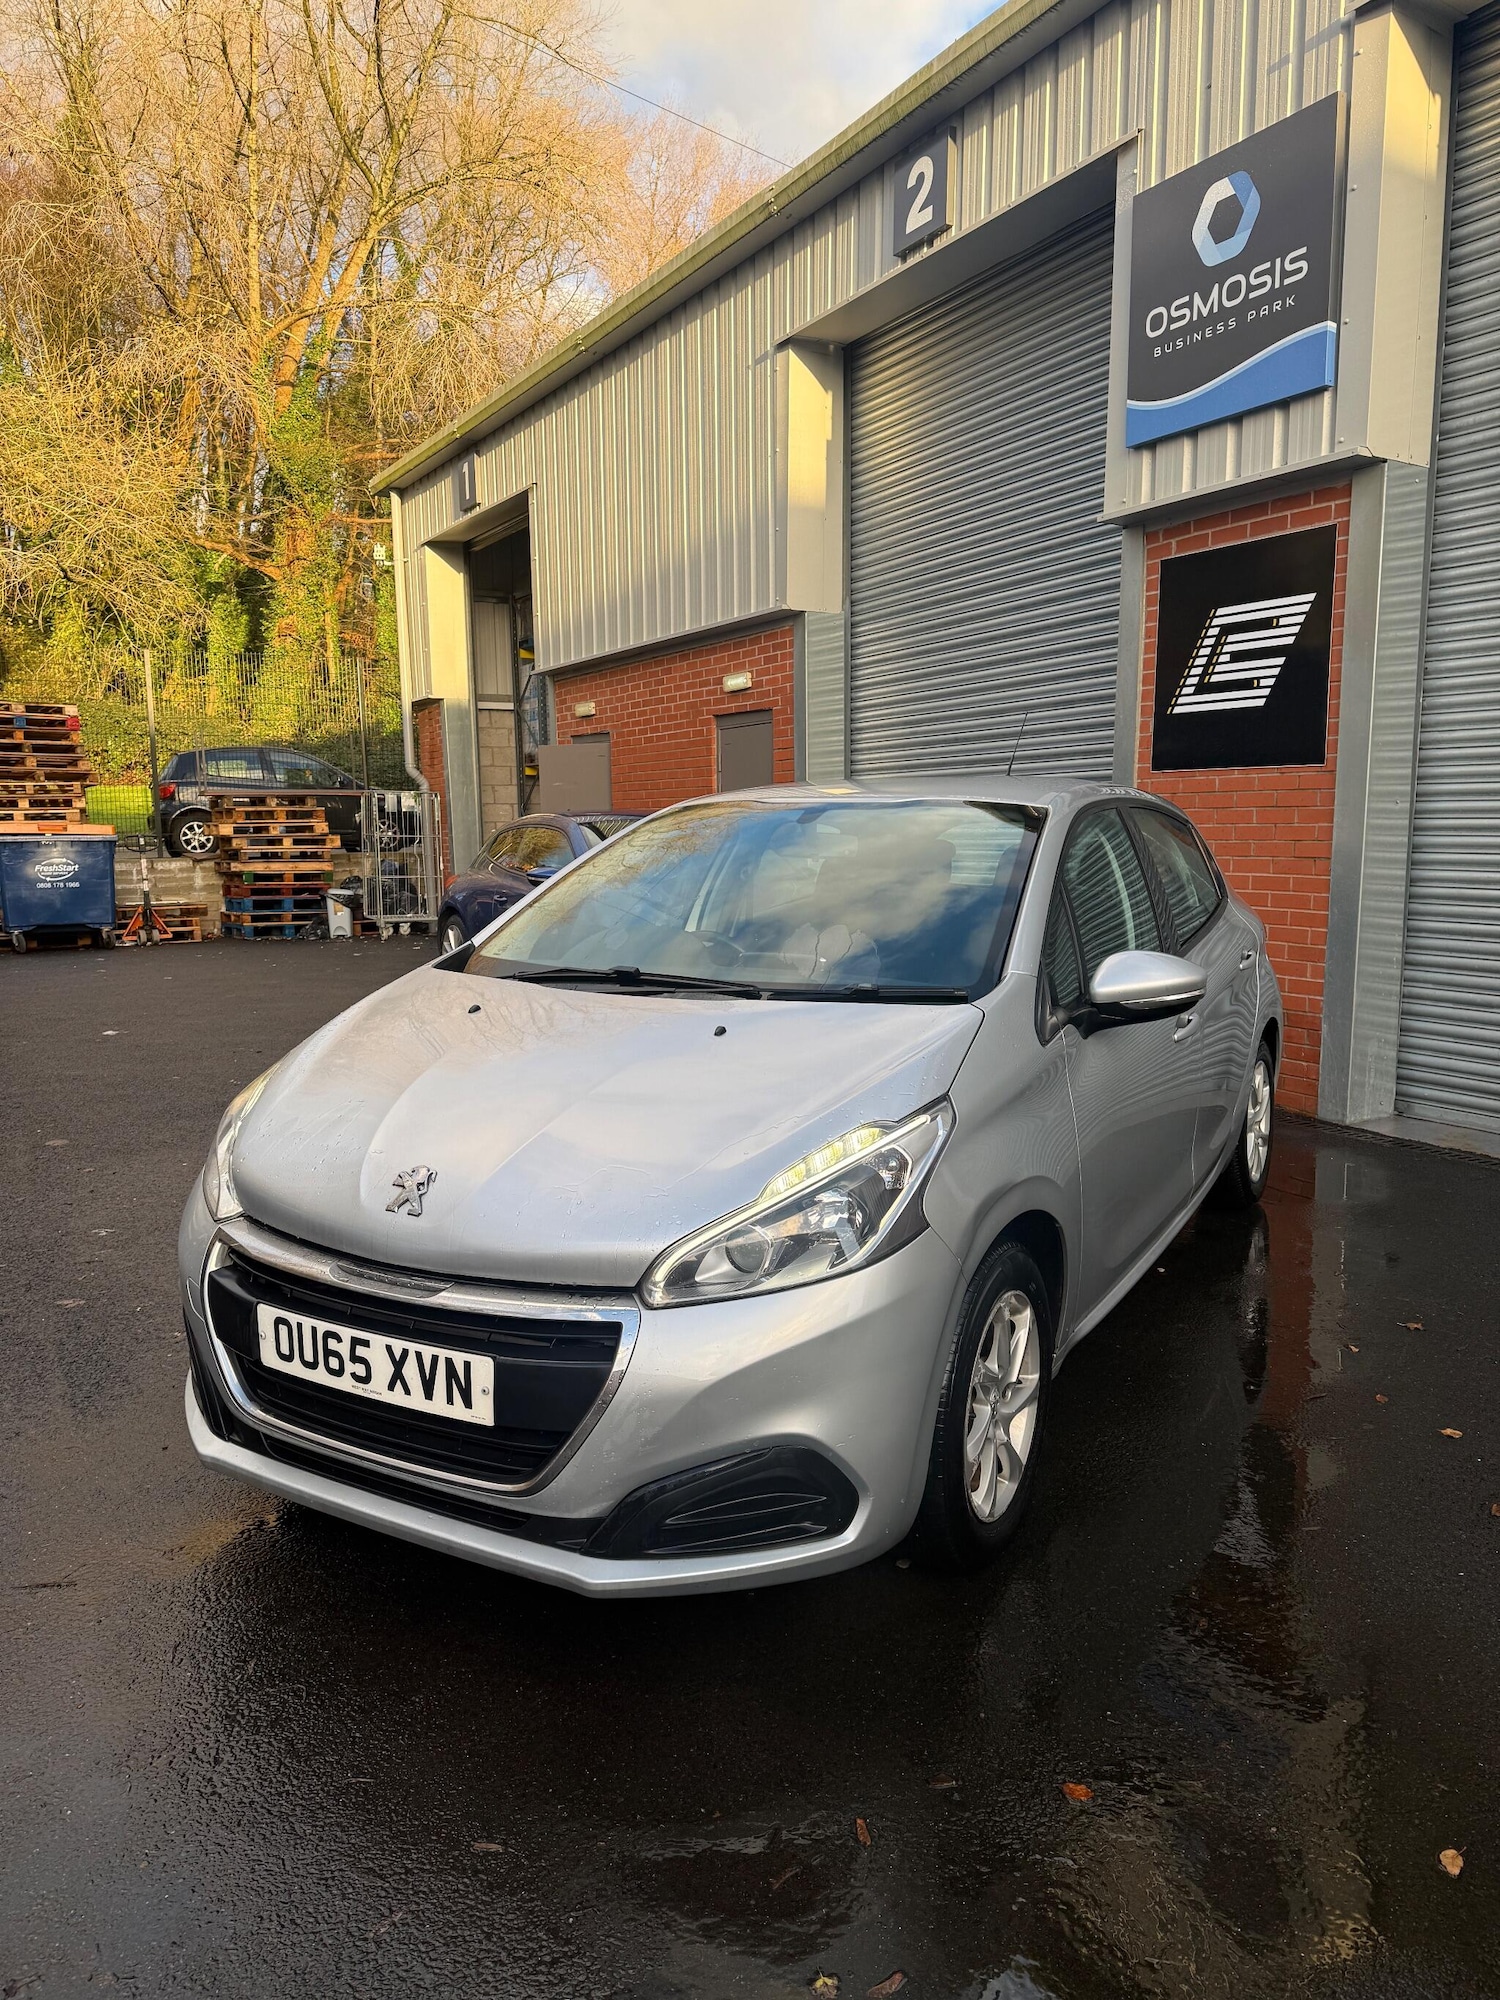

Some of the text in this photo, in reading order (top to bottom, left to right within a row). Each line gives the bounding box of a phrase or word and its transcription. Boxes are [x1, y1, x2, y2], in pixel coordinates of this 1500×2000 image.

[906, 155, 934, 235] 2
[1145, 246, 1309, 338] OSMOSIS
[1153, 294, 1296, 358] BUSINESS PARK
[462, 461, 470, 500] 1
[273, 1316, 473, 1410] OU65 XVN
